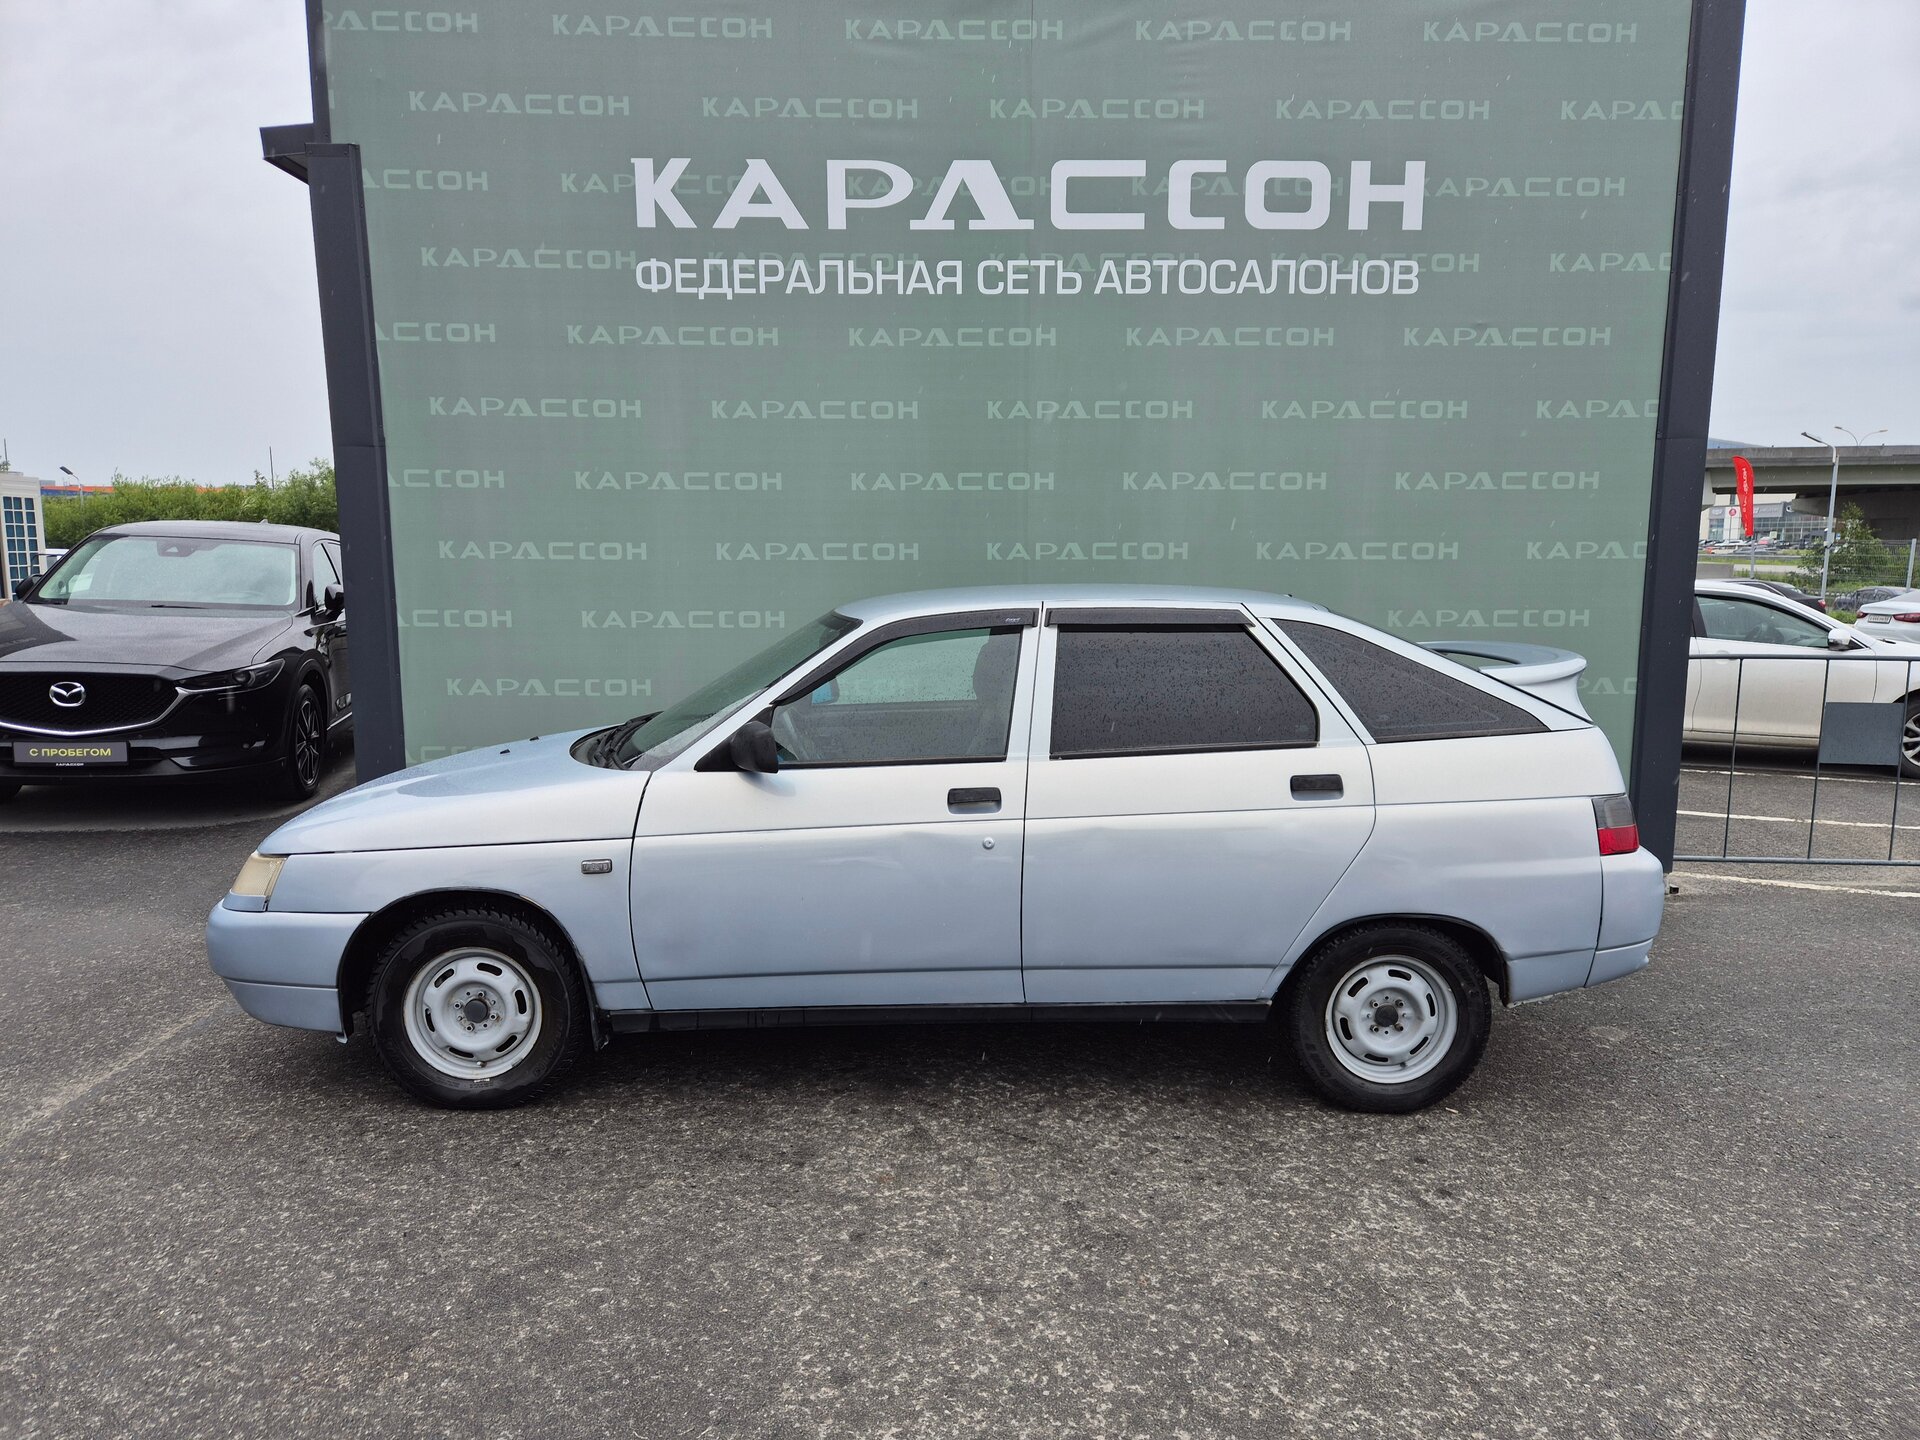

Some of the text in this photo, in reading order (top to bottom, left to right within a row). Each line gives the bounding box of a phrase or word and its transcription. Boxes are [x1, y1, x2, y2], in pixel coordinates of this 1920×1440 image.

[552, 14, 772, 39] КАРАССОН
[845, 18, 1063, 41] КАРАССОН
[1136, 20, 1351, 41] КАРАССОН
[1423, 21, 1637, 43] КАРАССОН
[408, 91, 630, 116] КАРАССОН
[702, 97, 918, 119] КАРАССОН
[990, 99, 1204, 119] КАРАССОН
[1276, 99, 1490, 120] КАРАССОН
[631, 158, 1426, 230] КАРАССОН
[420, 246, 636, 270] КАРАССОН
[636, 258, 1420, 300] ФЕДЕРАЛЬНАЯ СЕТЬ АВТОСАЛОНОВ
[566, 325, 779, 347] КАРАССОН
[848, 327, 1056, 347] КАРАССОН
[1126, 327, 1334, 347] КАРАССОН
[1403, 327, 1611, 347] КАРАССОН
[429, 397, 642, 418] КАРАССОН
[711, 400, 919, 419] КАРАССОН
[987, 400, 1193, 419] КАРАССОН
[1262, 400, 1468, 419] КАРАССОН
[574, 471, 783, 491] КАРАССОН
[850, 472, 1055, 491] КАРАССОН
[1122, 472, 1327, 491] КАРАССОН
[1395, 471, 1600, 490] КАРАССОН
[438, 540, 648, 560] КАРАССОН
[715, 543, 919, 561] КАРАССОН
[986, 542, 1189, 561] КАРАССОН
[1256, 542, 1459, 560] КАРАССОН
[581, 610, 786, 629] КАРАССОН
[1387, 609, 1590, 628] КАРАССОН
[446, 678, 652, 697] КАРАССОН
[29, 748, 112, 757] С ПРОБЕГОМ
